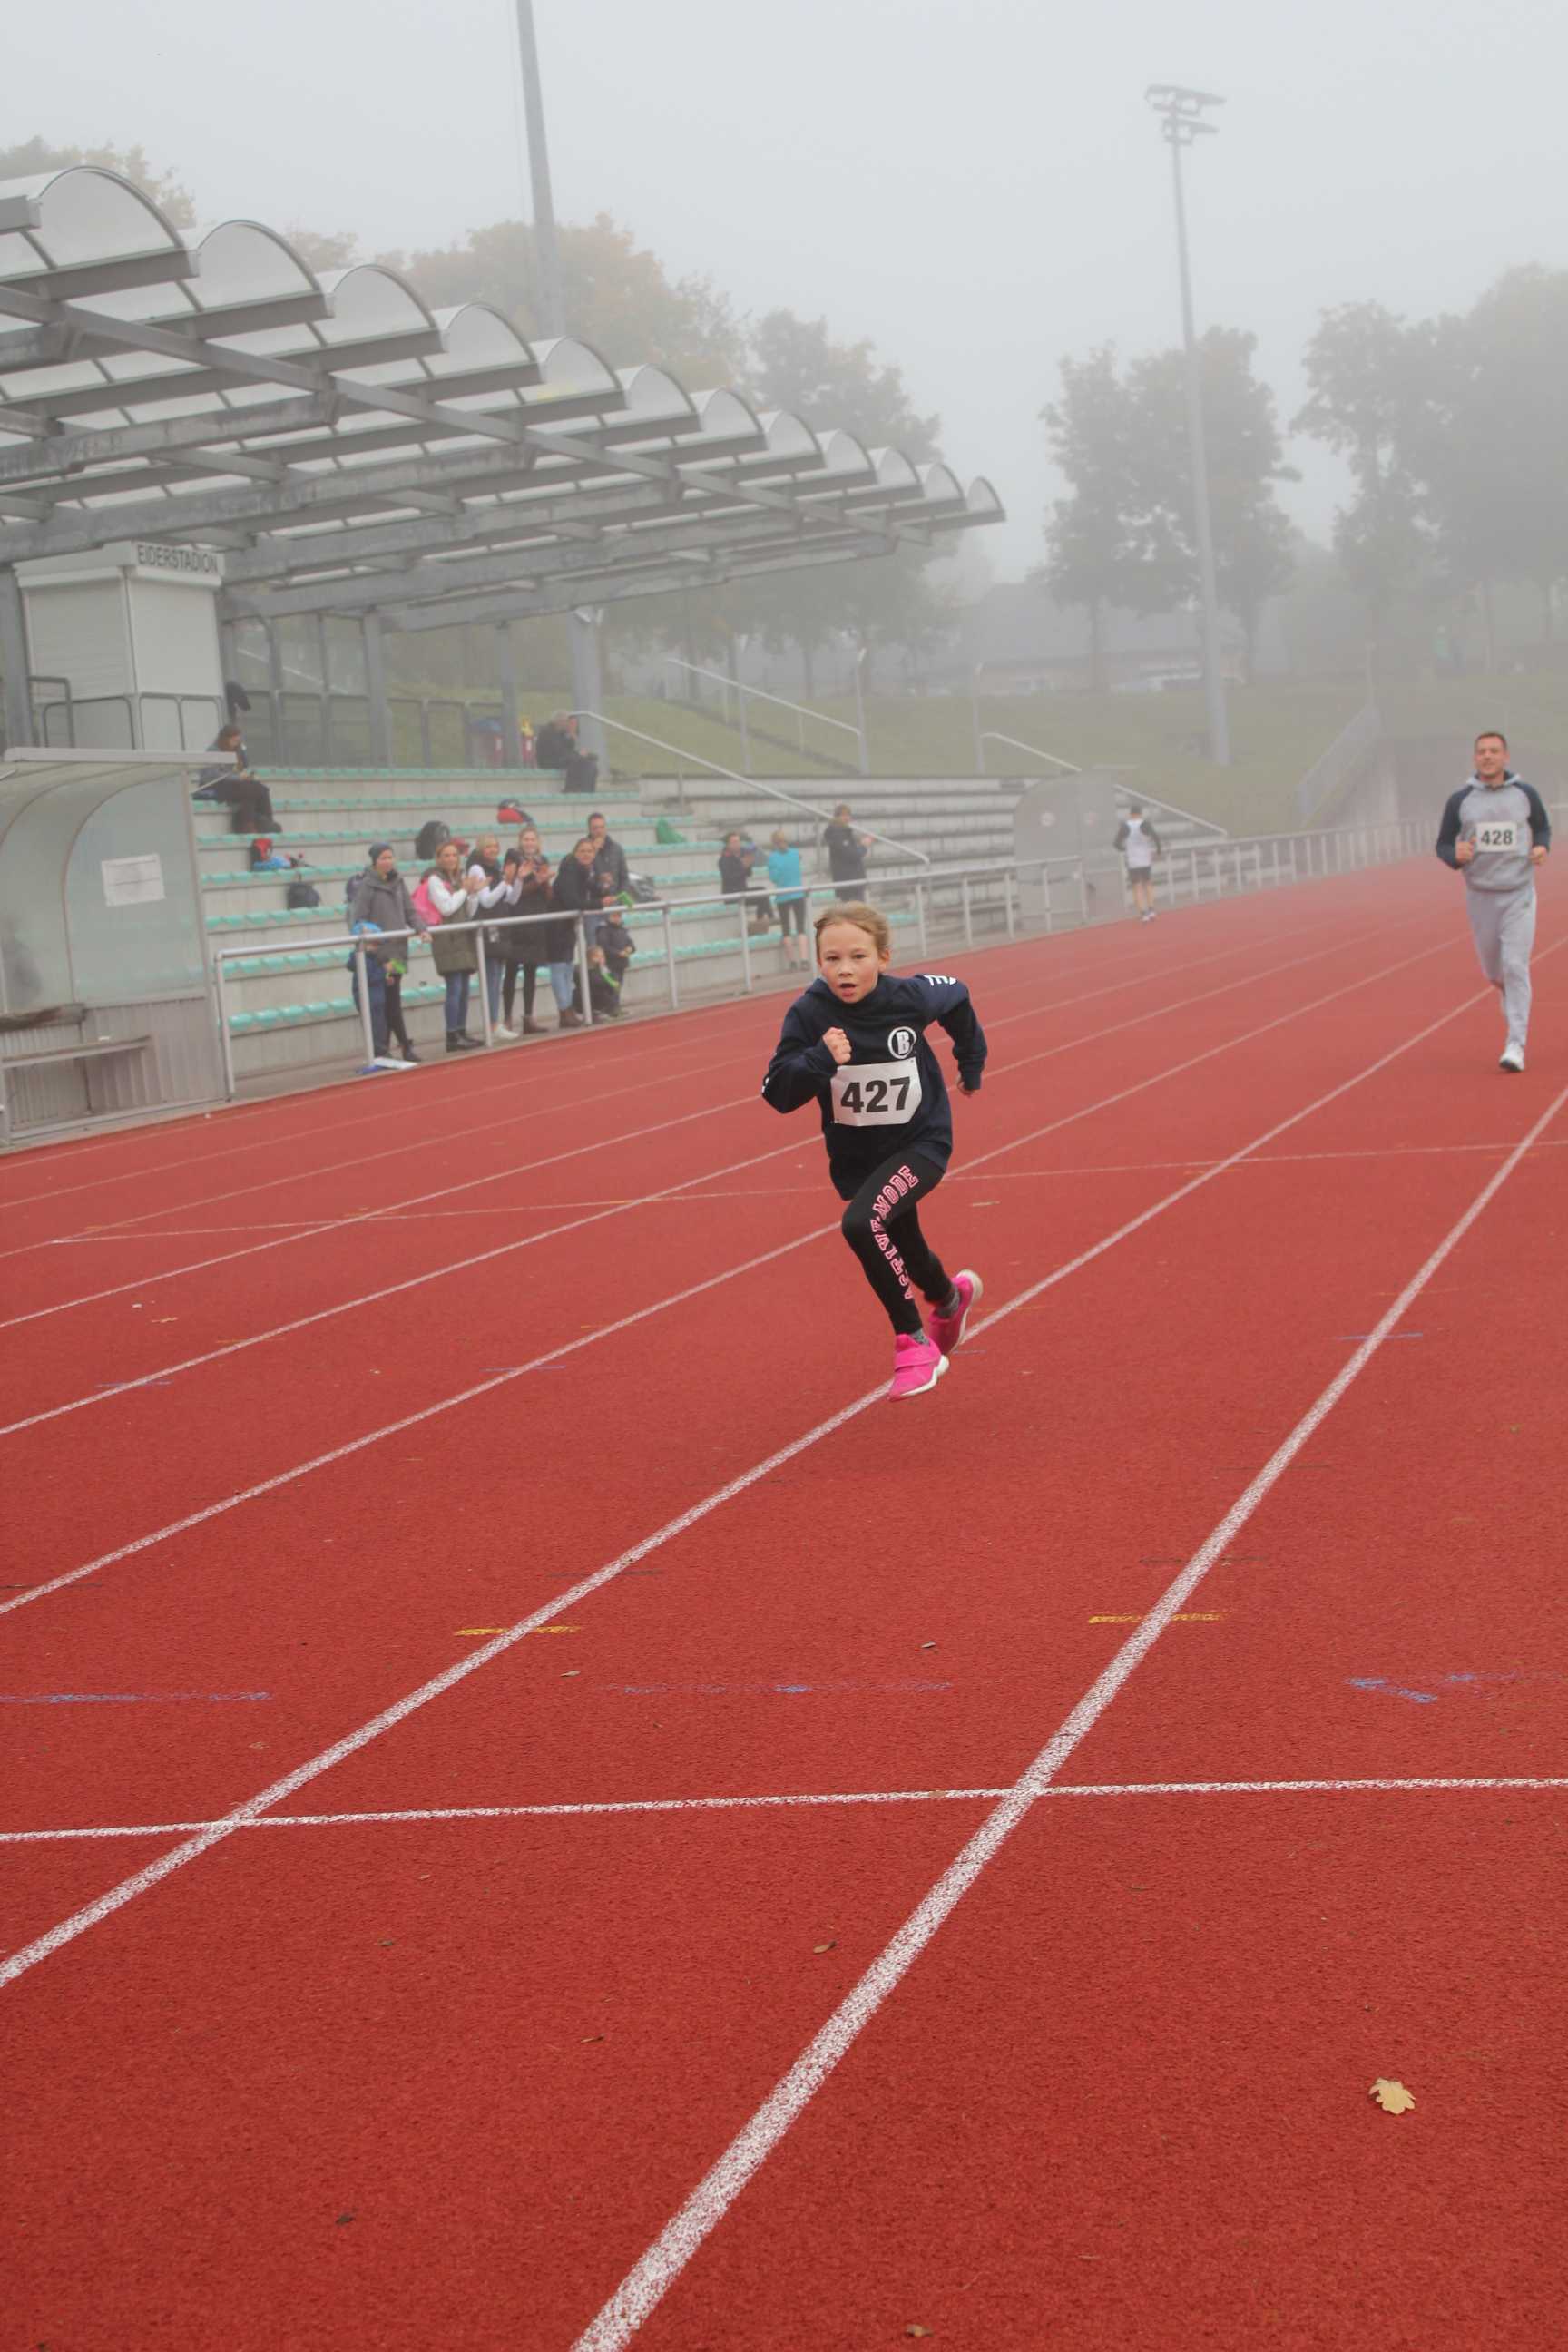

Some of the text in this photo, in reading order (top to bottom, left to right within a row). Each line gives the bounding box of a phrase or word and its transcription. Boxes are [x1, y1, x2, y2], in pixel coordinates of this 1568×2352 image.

[137, 544, 218, 573] EIDERSTADION
[1480, 829, 1513, 846] 428
[840, 1076, 911, 1114] 427
[872, 1165, 919, 1220] MODE
